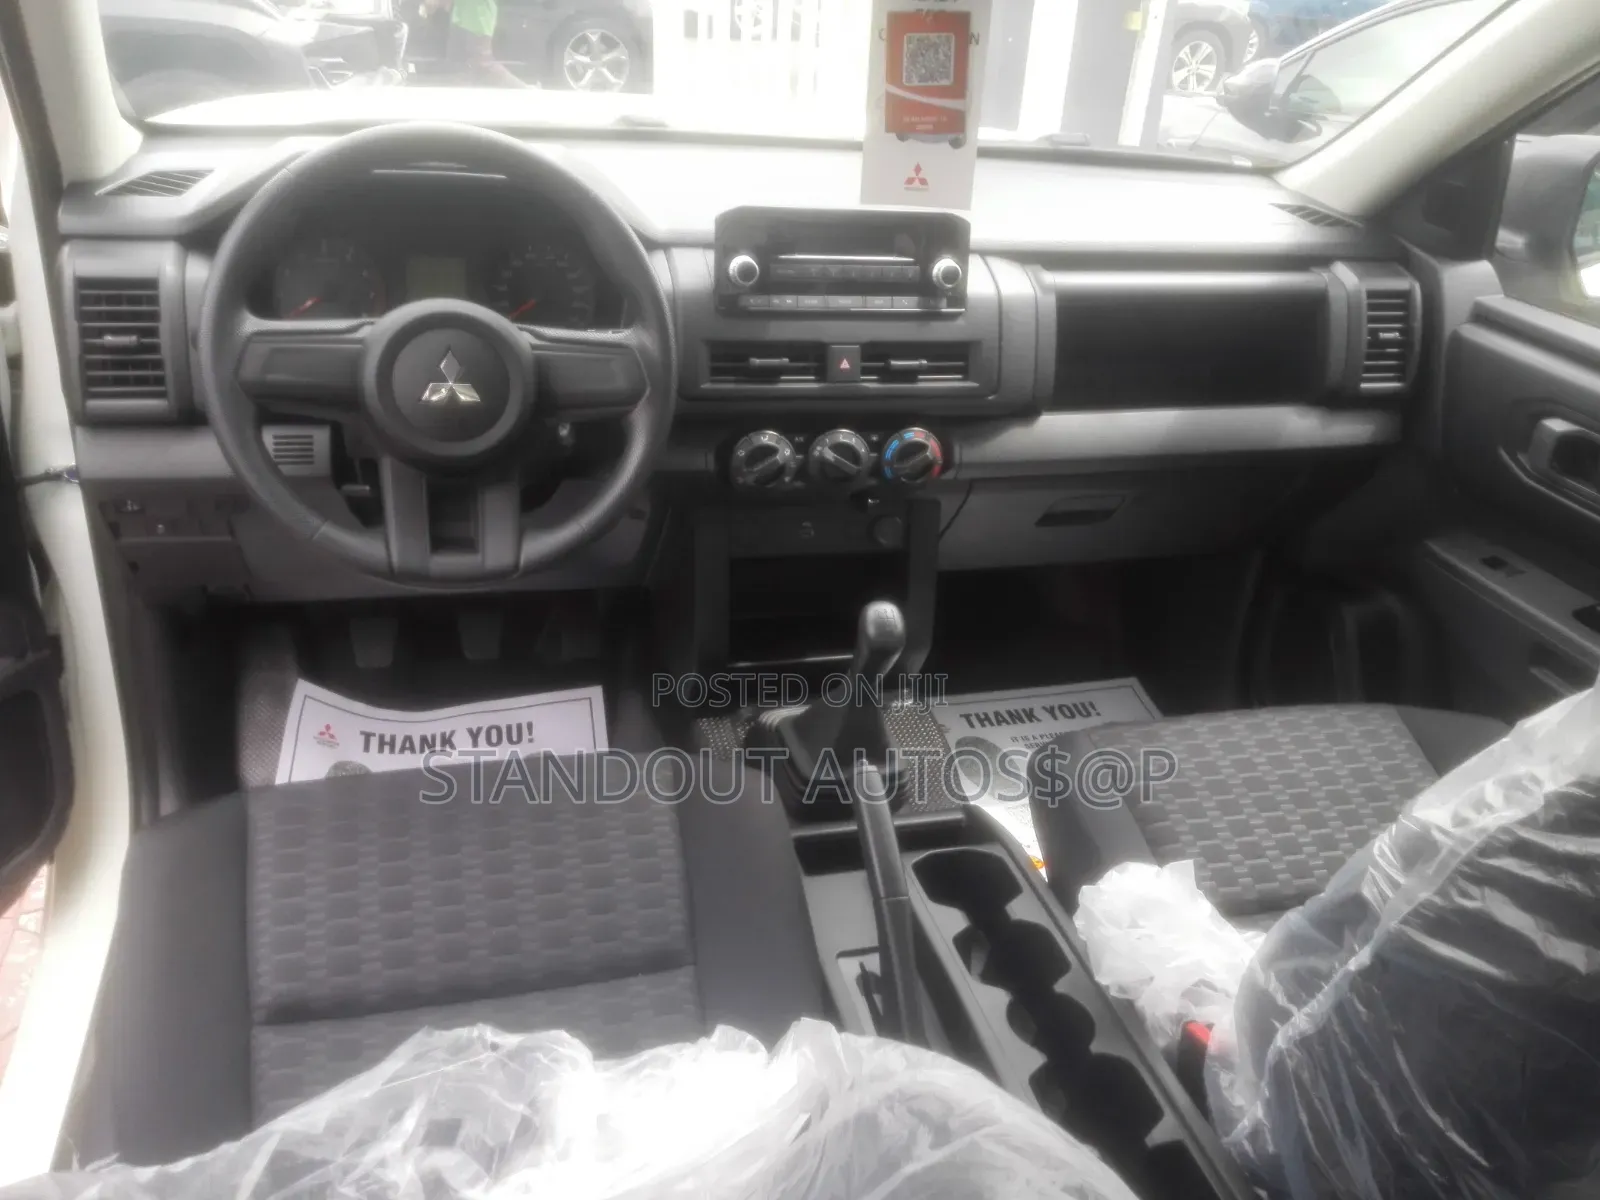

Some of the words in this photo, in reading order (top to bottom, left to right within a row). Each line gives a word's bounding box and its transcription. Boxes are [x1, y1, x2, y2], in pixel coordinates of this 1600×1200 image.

[959, 706, 1042, 730] THANK
[1041, 701, 1102, 721] YOU!
[359, 728, 458, 755] THANK
[466, 721, 535, 749] YOU!
